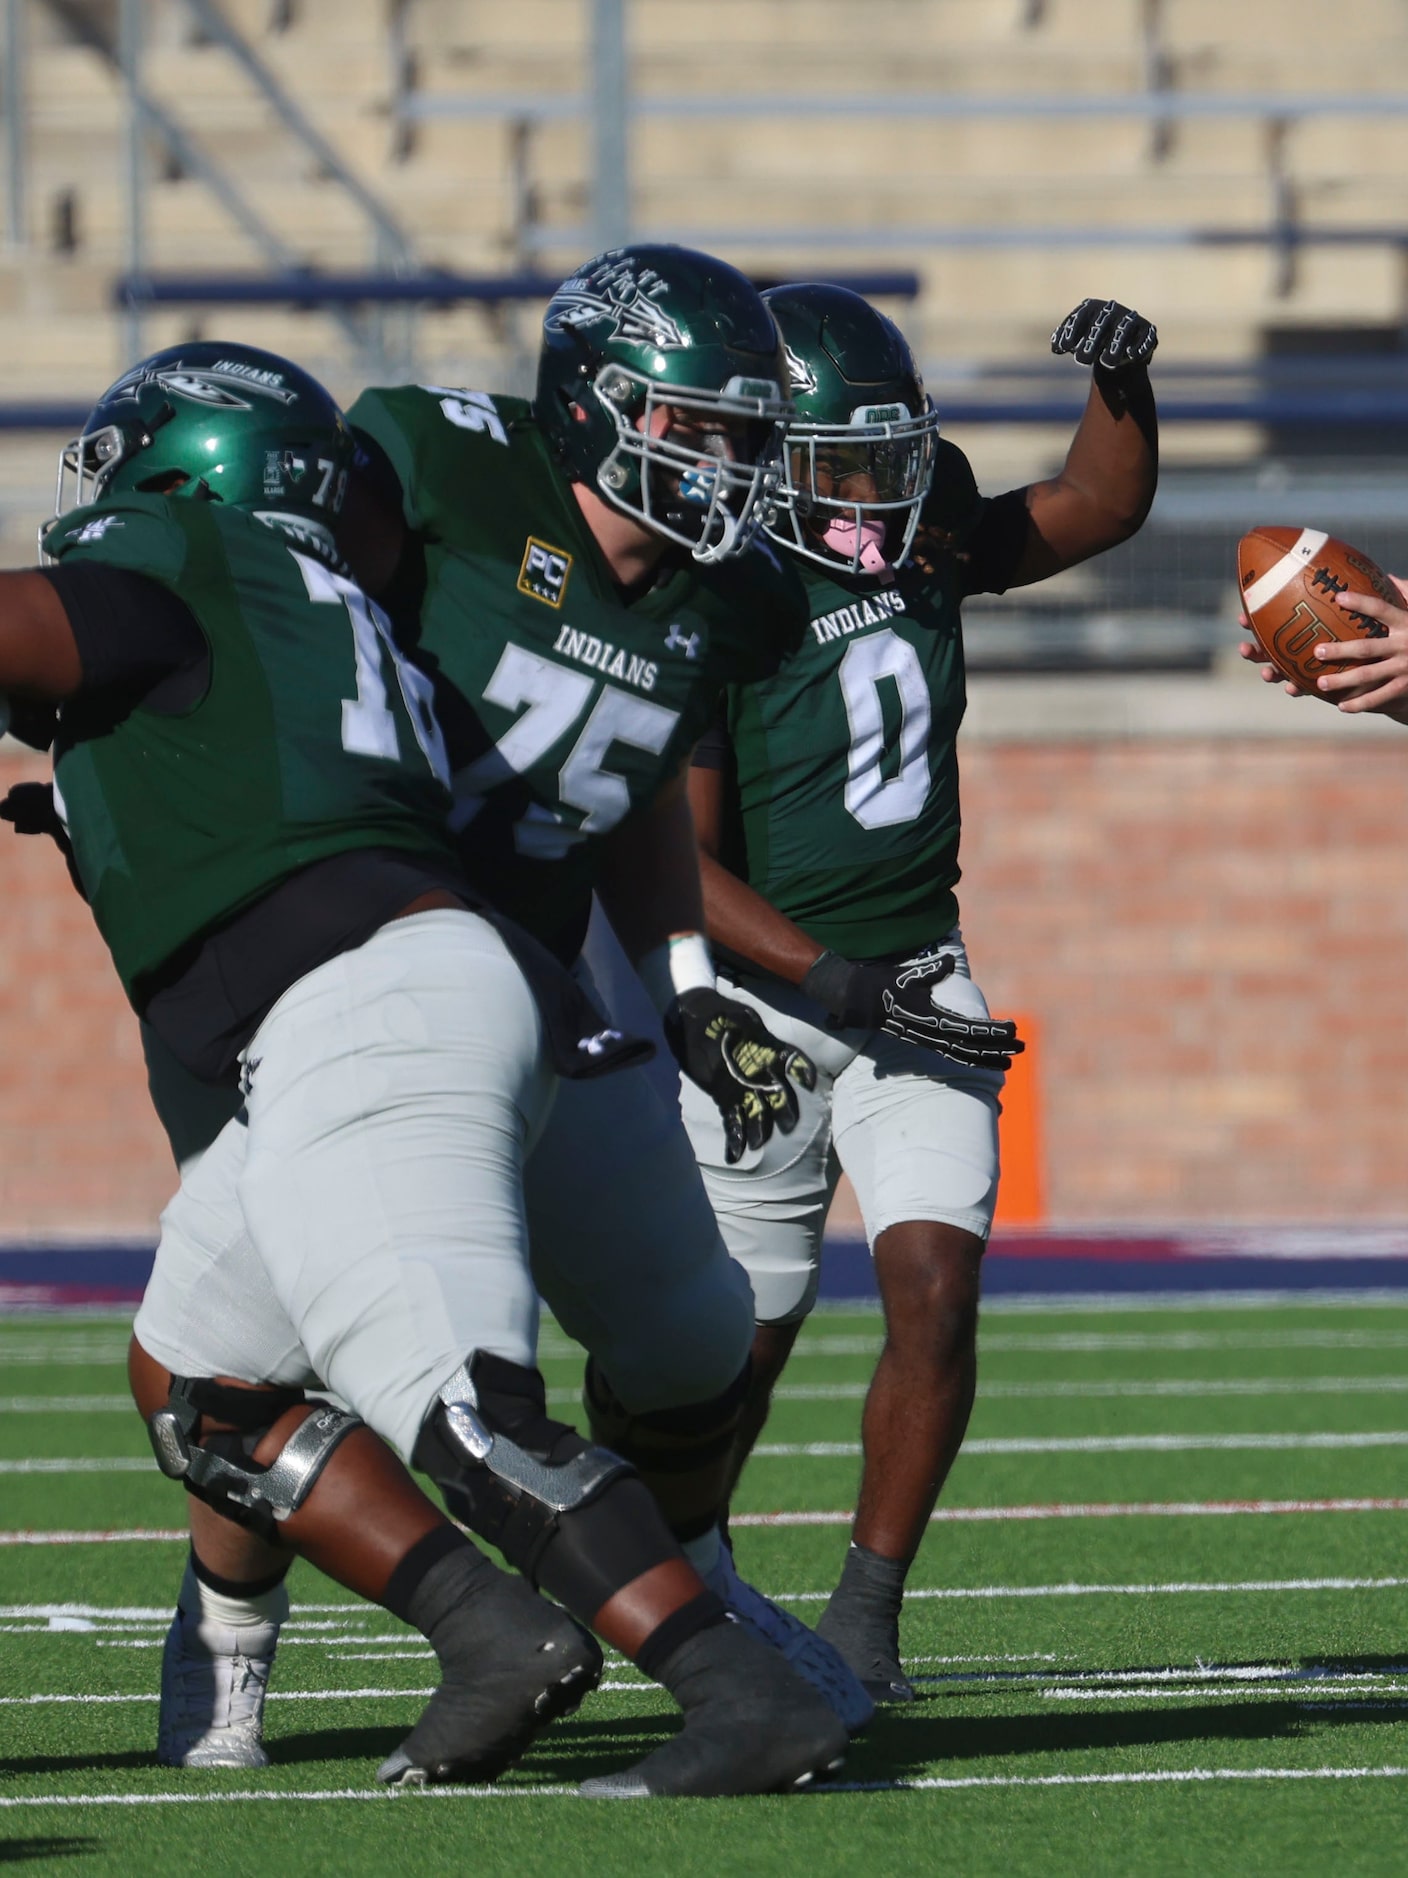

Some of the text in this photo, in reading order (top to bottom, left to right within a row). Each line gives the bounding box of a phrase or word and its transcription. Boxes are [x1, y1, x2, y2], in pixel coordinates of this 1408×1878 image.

[211, 359, 284, 387] INDIANS
[525, 544, 568, 586] PC
[810, 589, 906, 646] INDIANS
[552, 623, 659, 691] INDIANS
[448, 640, 681, 861] 75
[838, 627, 932, 830] 0
